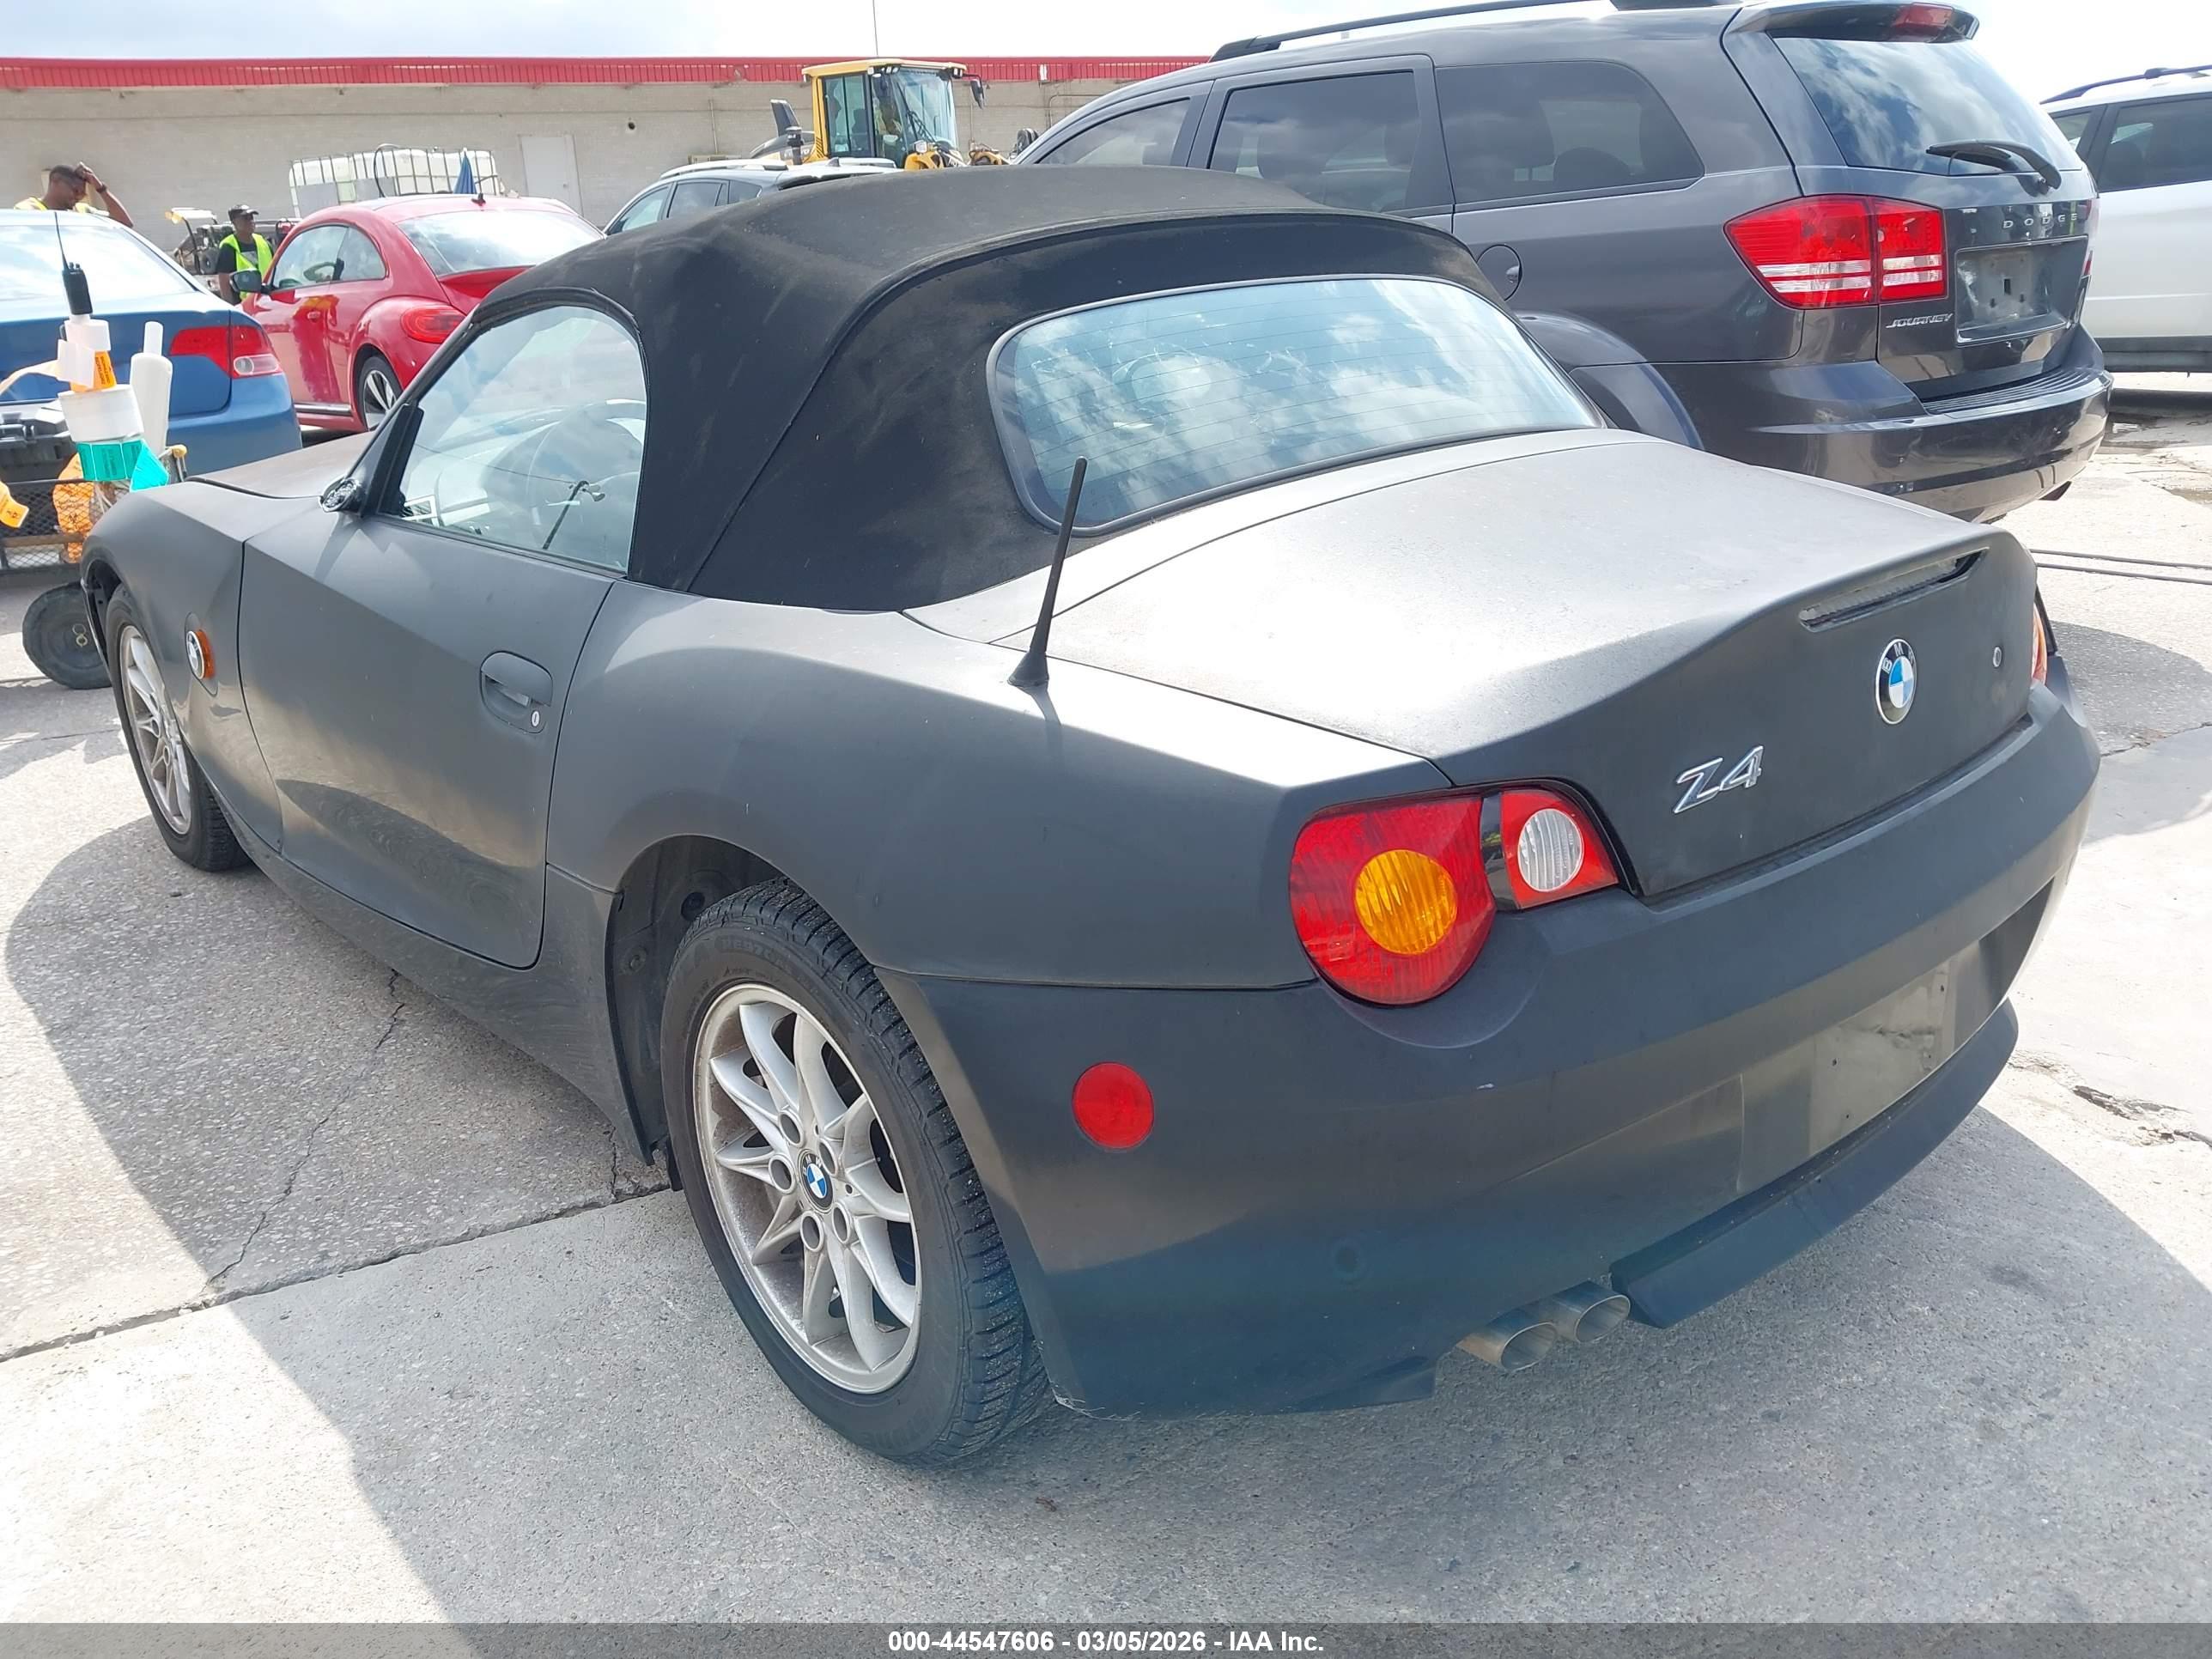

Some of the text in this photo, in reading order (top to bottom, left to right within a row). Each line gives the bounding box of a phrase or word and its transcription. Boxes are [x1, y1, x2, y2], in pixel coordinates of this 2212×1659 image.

[2002, 213, 2078, 229] DODGE
[1885, 313, 1954, 328] JOURNEY
[1674, 745, 1764, 813] Z4
